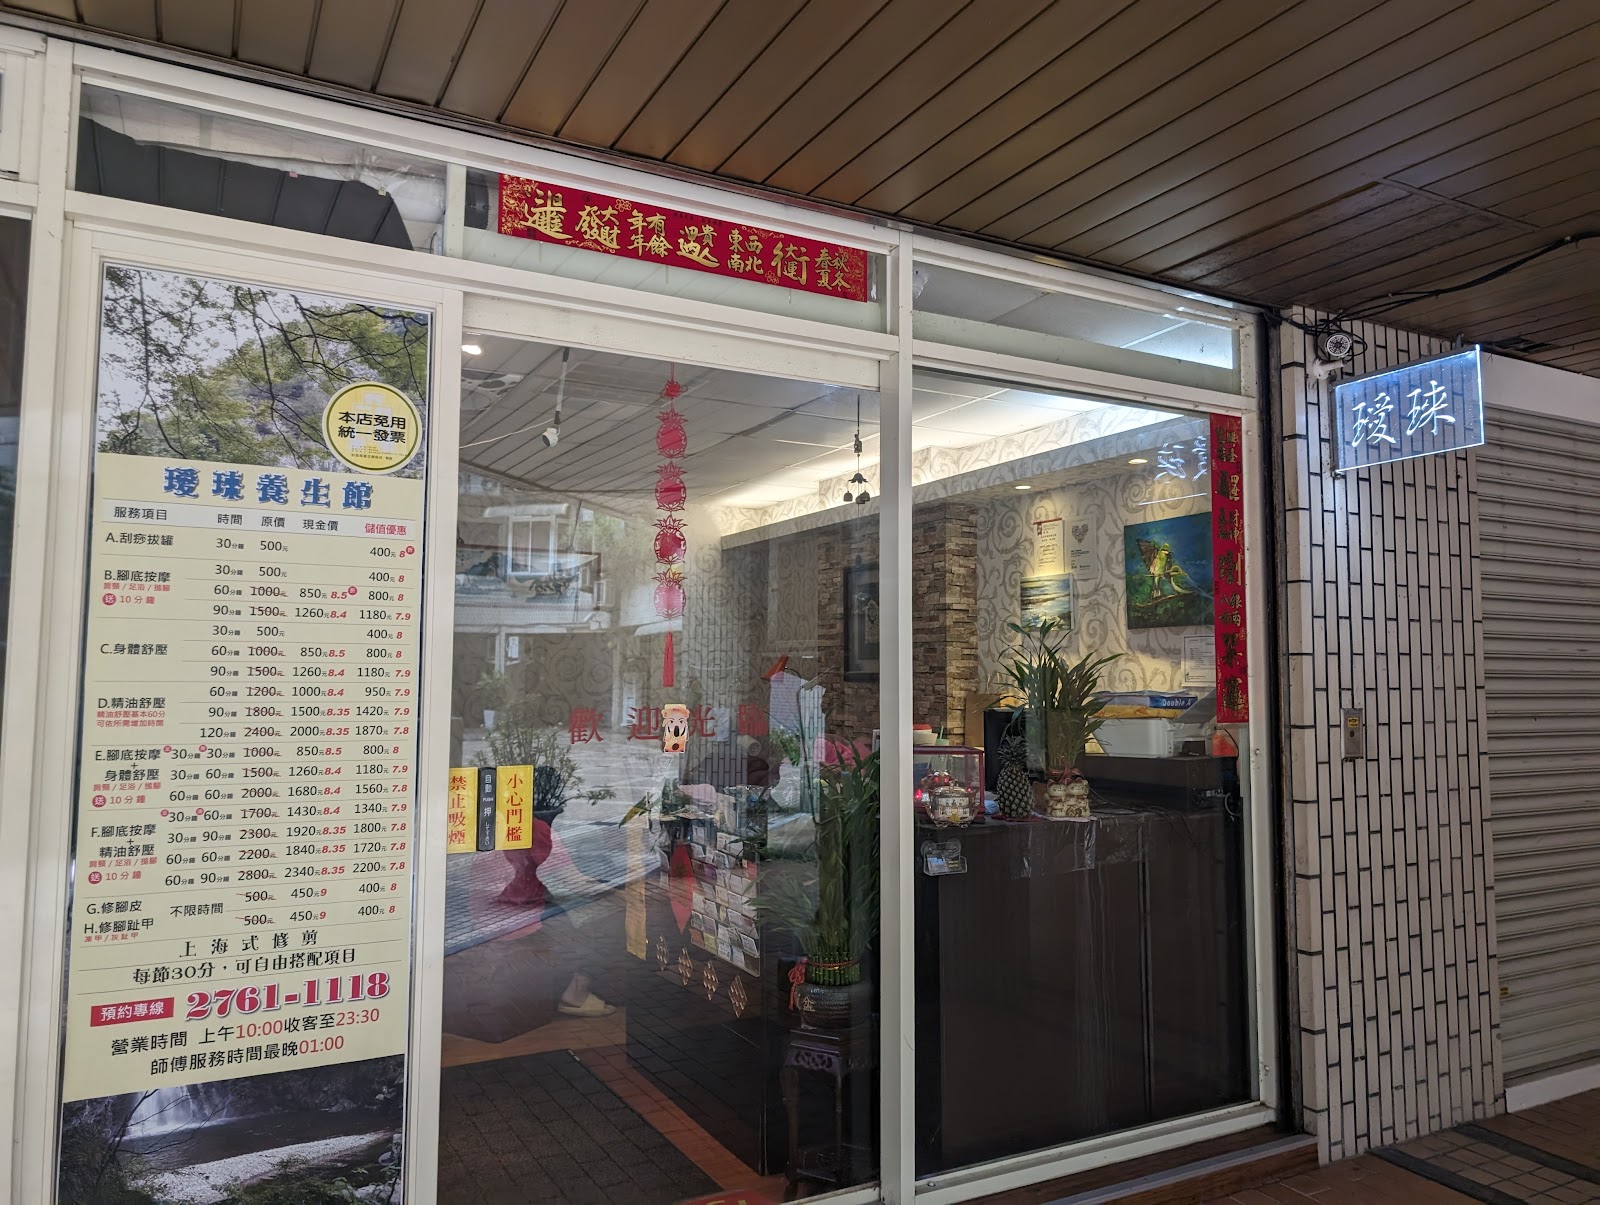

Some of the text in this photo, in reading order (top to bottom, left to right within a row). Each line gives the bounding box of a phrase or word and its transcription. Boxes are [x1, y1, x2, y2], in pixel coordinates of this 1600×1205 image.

[338, 411, 406, 430] 本店免用
[338, 425, 406, 444] 統一發票
[1162, 698, 1186, 708] Double
[568, 703, 769, 745] 歡迎光臨
[448, 775, 467, 846] 禁止吸煙
[505, 773, 524, 843] 小心門檻
[179, 929, 319, 958] 上海式修剪
[100, 971, 390, 1022] 預約專線 2761-1118
[111, 1030, 188, 1056] 營業時間
[150, 1035, 344, 1076] 師傅服務時間最晚01:00
